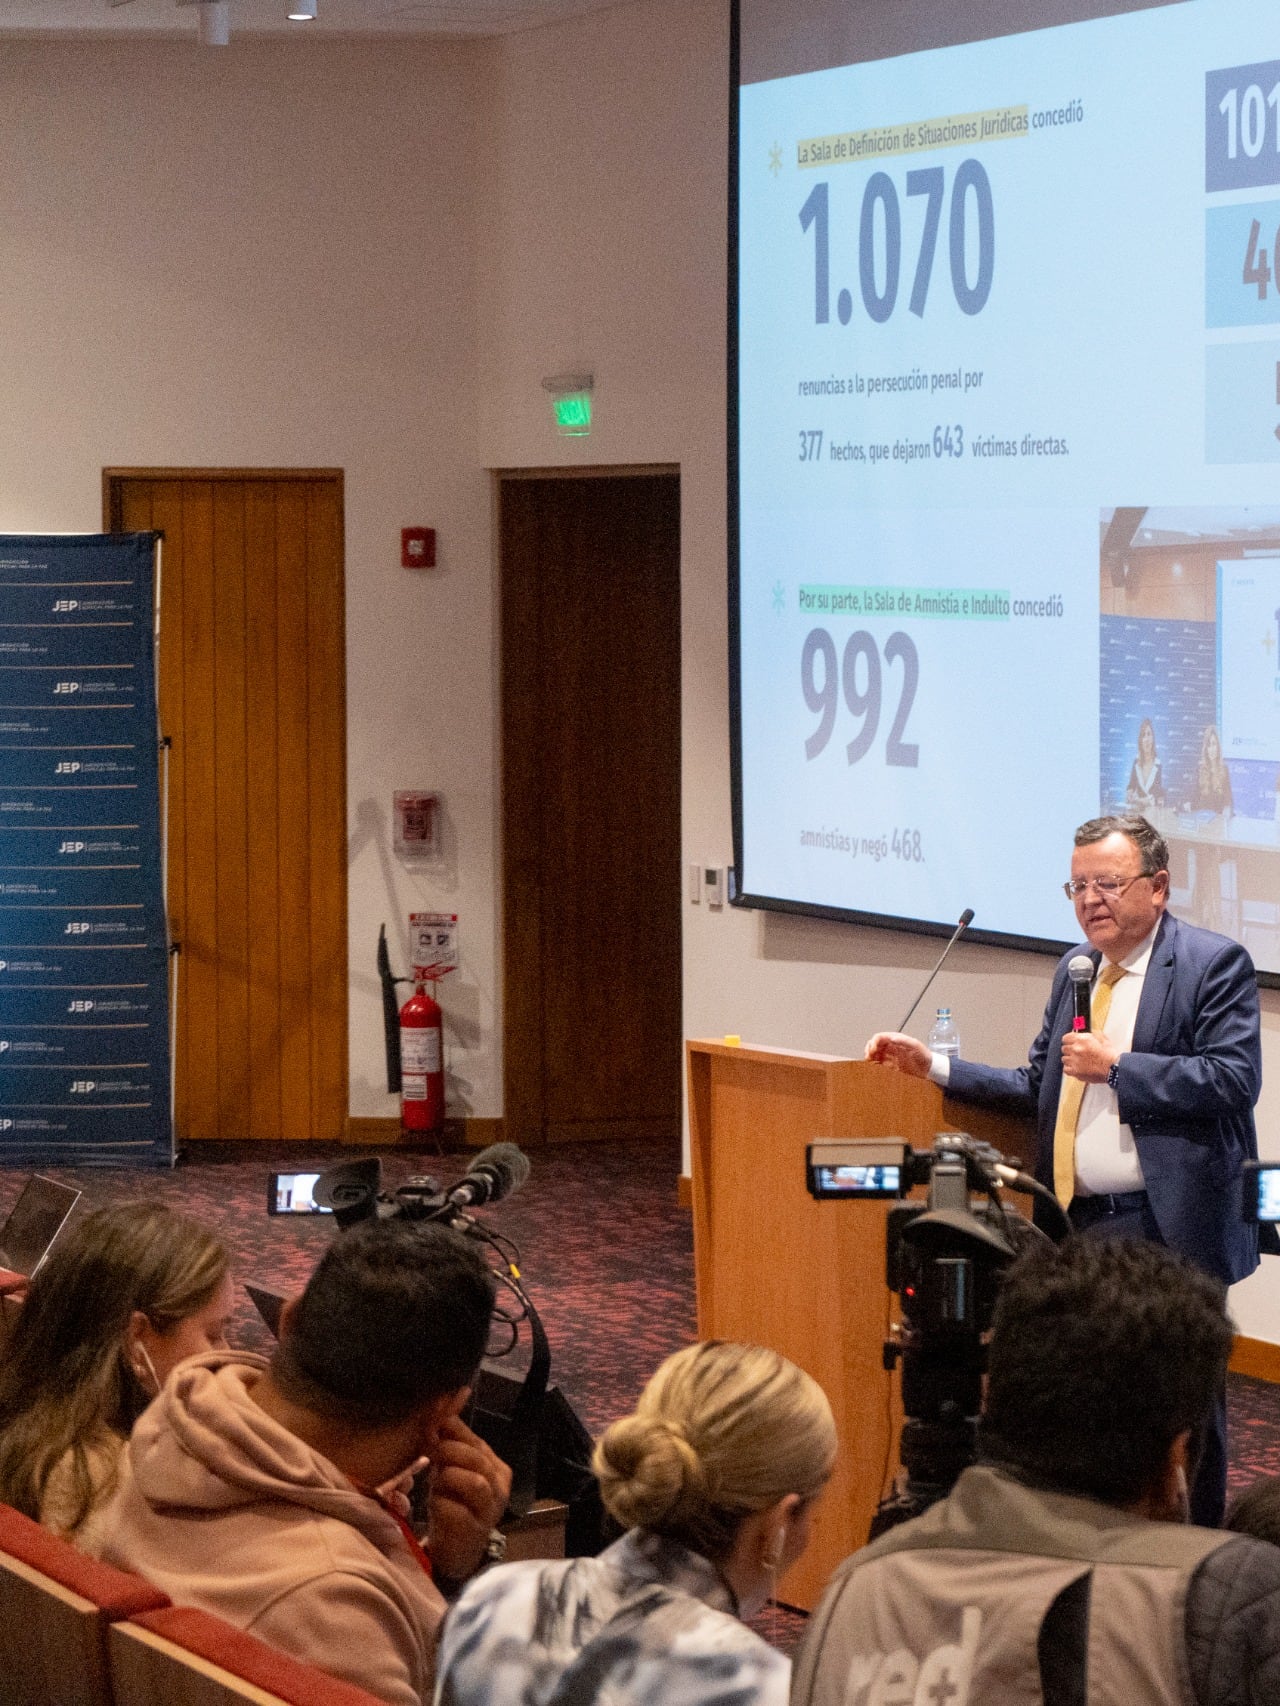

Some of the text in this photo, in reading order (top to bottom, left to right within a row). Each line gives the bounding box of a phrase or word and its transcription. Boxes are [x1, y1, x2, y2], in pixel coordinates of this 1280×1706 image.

[797, 145, 808, 163] La
[811, 141, 831, 161] Sala
[834, 139, 846, 158] de
[849, 129, 900, 156] Definición
[903, 128, 915, 148] de
[918, 120, 977, 146] Situaciones
[1032, 98, 1083, 129] concedió
[798, 158, 995, 326] 1.070
[799, 368, 984, 397] renuncias a la persecución penal por
[799, 424, 1070, 464] 377 hechos, que dejaron 643 víctimas directas.
[52, 600, 78, 612] JEP
[799, 589, 817, 608] Por
[818, 593, 829, 609] su
[832, 591, 861, 614] parte,
[864, 590, 873, 611] la
[875, 591, 895, 611] Sala
[898, 591, 911, 612] de
[962, 599, 969, 614] e
[971, 594, 1010, 616] Indulto
[1013, 594, 1064, 617] concedió
[53, 682, 79, 694] JEP
[801, 627, 920, 769] 992
[55, 762, 80, 774] JEP
[58, 841, 84, 853] JEP
[852, 837, 859, 859] y
[861, 834, 888, 862] negó
[891, 827, 925, 863] 468.
[64, 922, 90, 934] JEP
[68, 1000, 93, 1012] JEP
[70, 1081, 95, 1093] JEP
